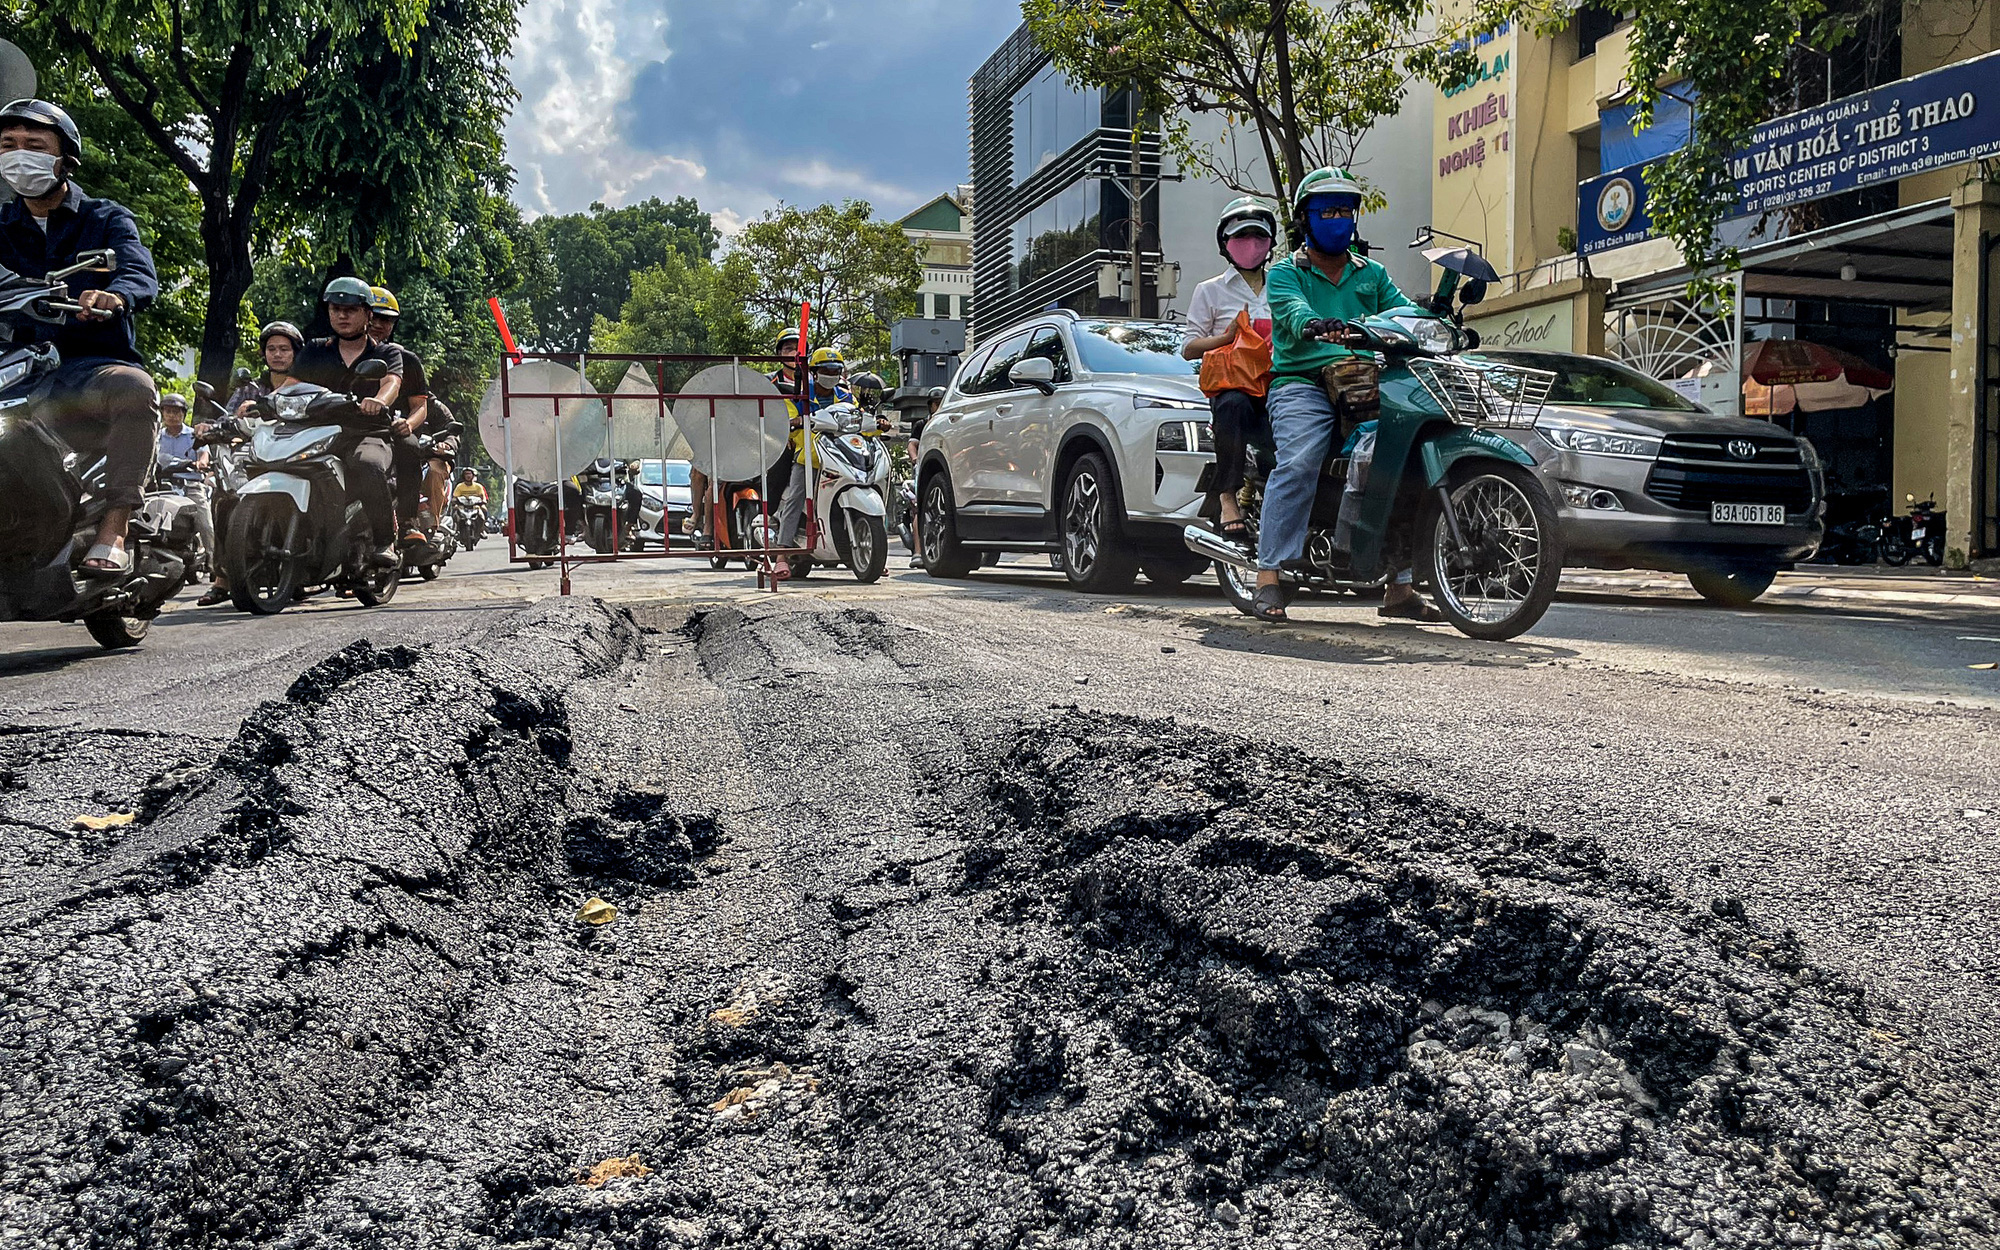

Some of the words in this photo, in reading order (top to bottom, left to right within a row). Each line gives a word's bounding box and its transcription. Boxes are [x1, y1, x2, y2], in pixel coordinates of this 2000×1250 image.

[1753, 143, 1793, 174] VĂN
[1797, 127, 1841, 163] HÓA
[1855, 99, 1901, 147] THỂ
[1907, 91, 1976, 132] THAO
[1768, 121, 1798, 141] NHÂN
[1801, 114, 1823, 131] DÂN
[1827, 102, 1860, 122] QUẬN
[1862, 100, 1869, 112] 3
[1743, 173, 1786, 198] SPORTS
[1790, 162, 1836, 186] CENTER
[1839, 154, 1856, 173] OF
[1858, 137, 1918, 168] DISTRICT
[1921, 135, 1930, 151] 3
[1857, 168, 1887, 184] Email:
[1798, 185, 1814, 199] 326
[1815, 181, 1832, 196] 327
[1584, 239, 1594, 253] Số
[1595, 239, 1606, 249] 126
[1606, 235, 1624, 246] Cách
[1625, 231, 1644, 243] Mạng
[1504, 313, 1557, 347] School
